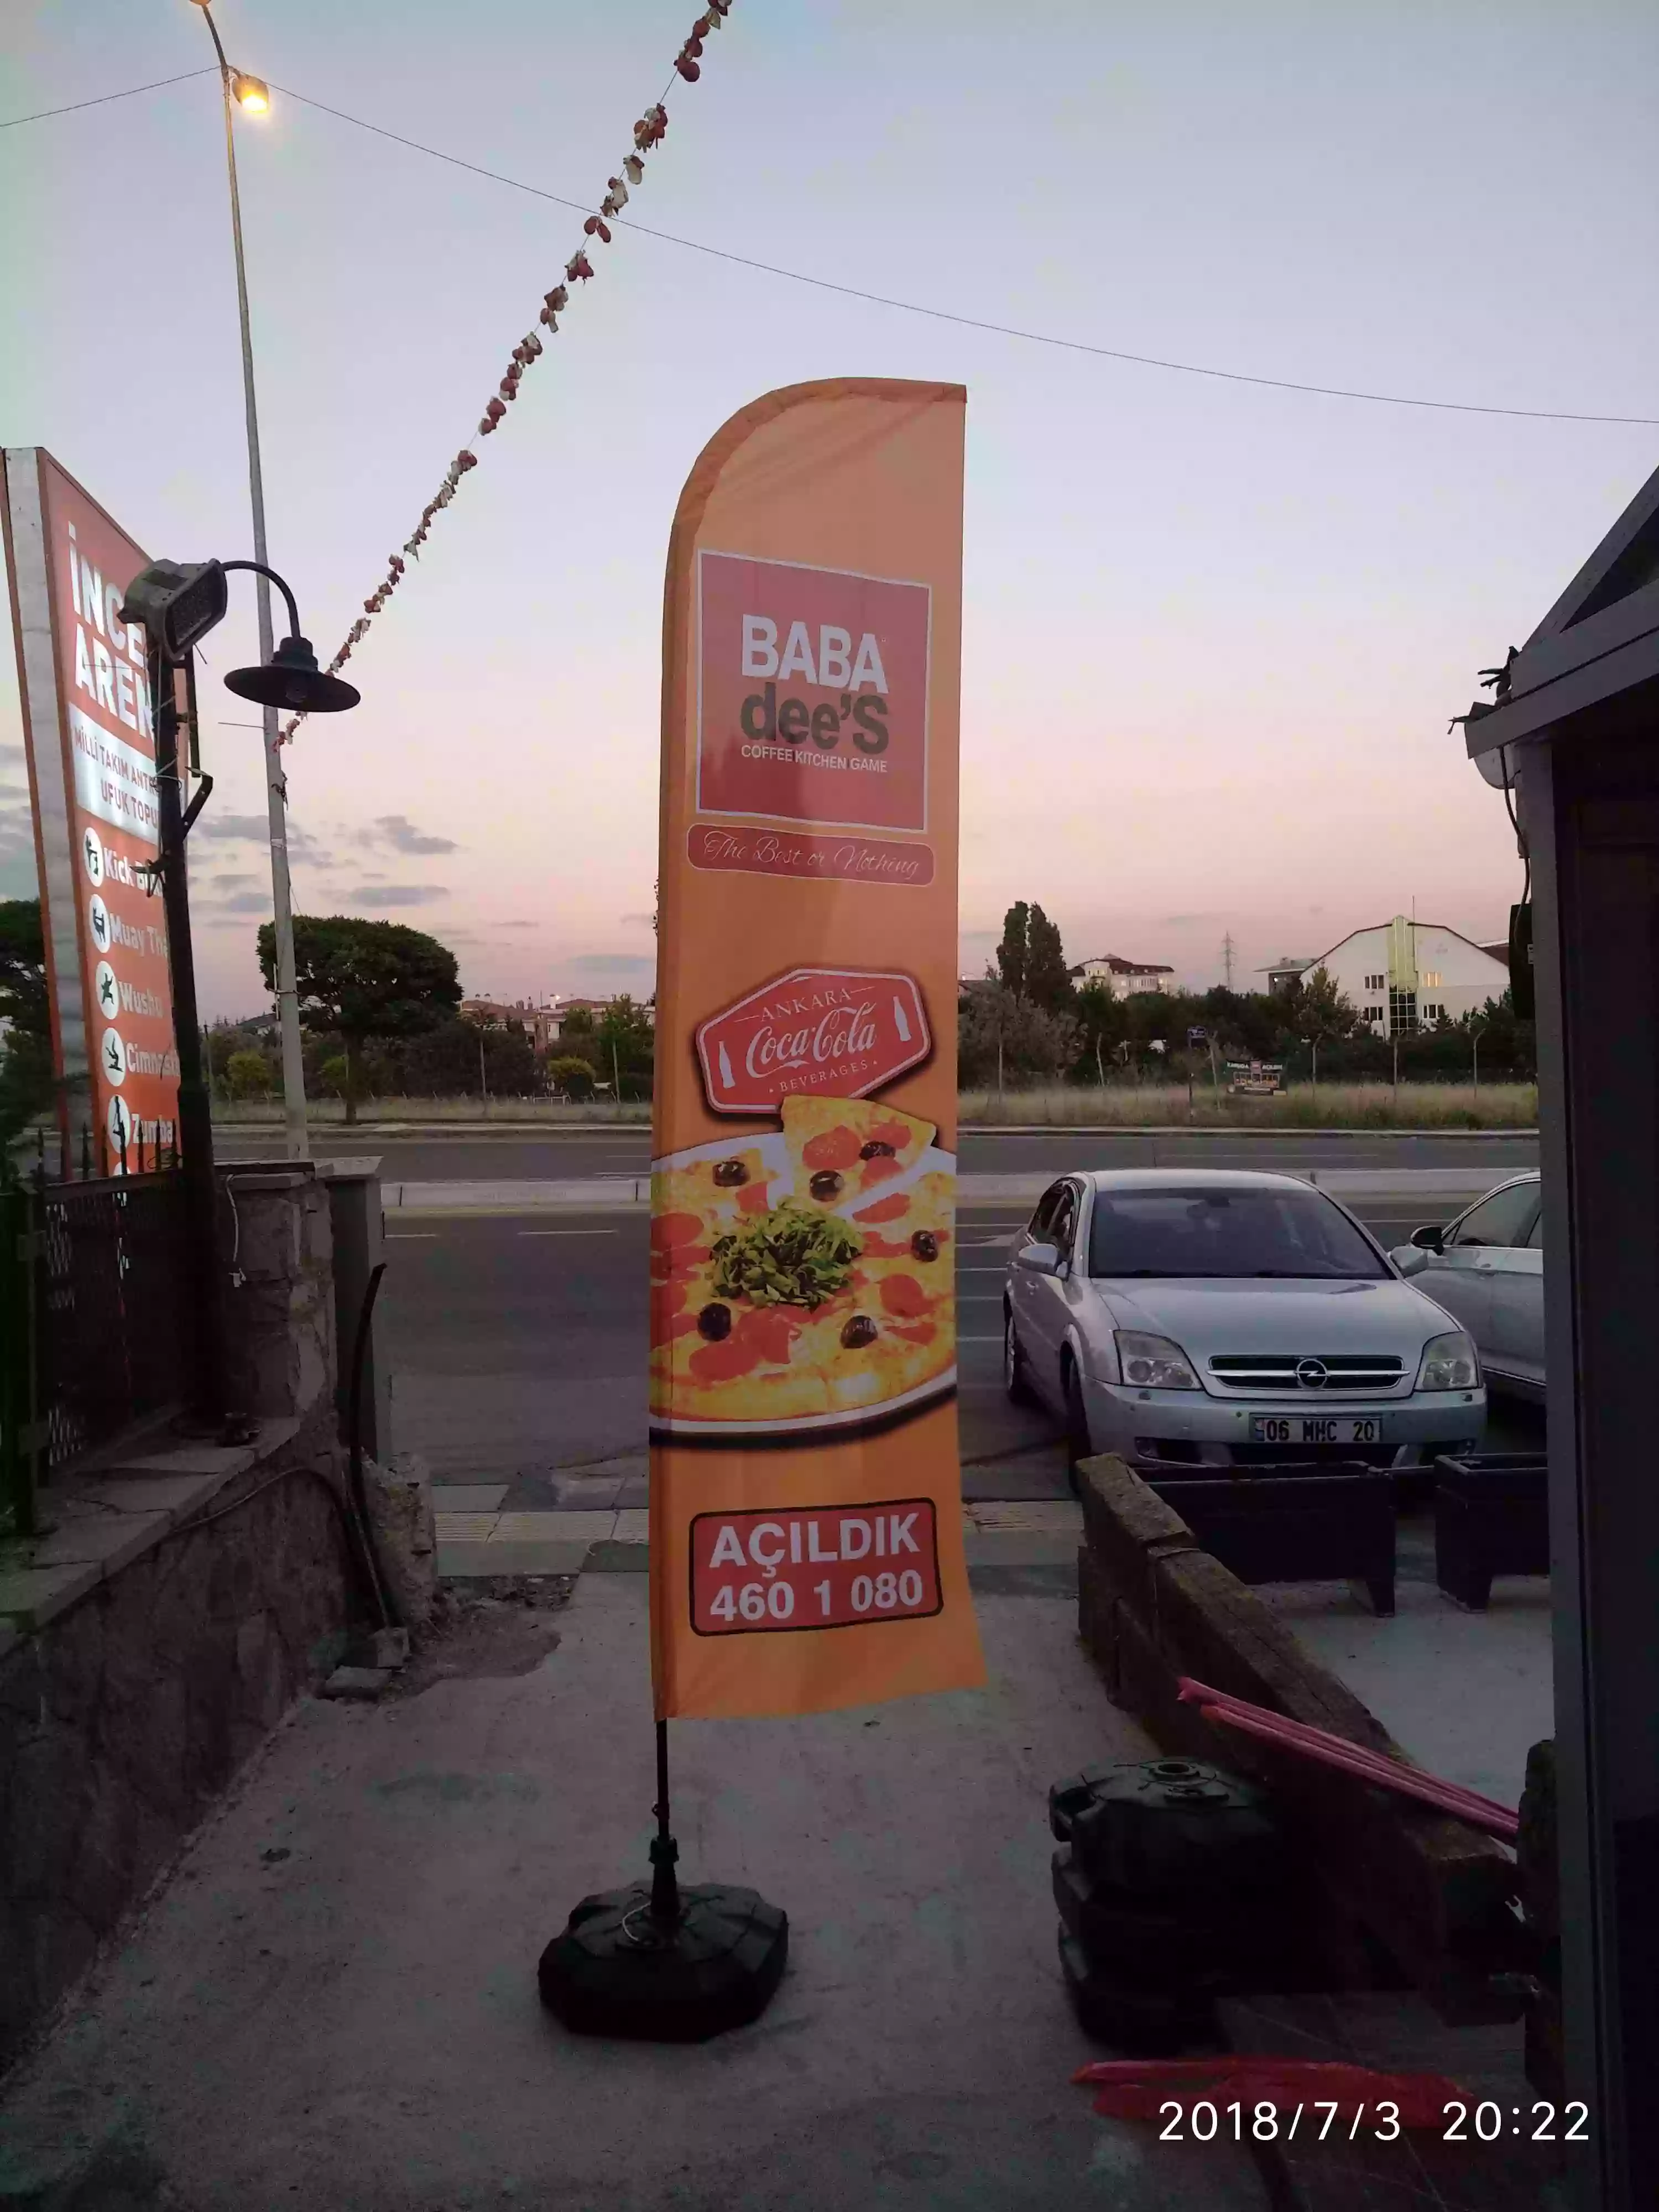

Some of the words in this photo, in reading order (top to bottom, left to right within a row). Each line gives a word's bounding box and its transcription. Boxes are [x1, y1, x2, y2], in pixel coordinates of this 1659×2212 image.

[68, 520, 147, 669] İNCE
[741, 613, 889, 694] BABA
[75, 623, 155, 744] AREN
[740, 682, 890, 755] dee'S
[74, 726, 98, 761] MİLLİ
[100, 744, 129, 781] TAKIM
[741, 744, 793, 762] COFFEE
[795, 750, 847, 770] KITCHEN
[850, 758, 888, 773] GAME
[101, 777, 130, 815] UFUK
[131, 796, 159, 829] TOPU
[103, 847, 135, 888] Kick
[703, 831, 748, 860] The
[754, 836, 803, 865] Best
[807, 853, 825, 867] or
[833, 845, 920, 880] Nothing
[109, 912, 145, 957] Muay
[118, 980, 164, 1019] Wushu
[760, 987, 853, 1022] ANKARA
[779, 1059, 868, 1092] BEVERAGES
[131, 1113, 173, 1145] Zumba
[1266, 1420, 1290, 1441] 06
[1302, 1420, 1337, 1442] MHC
[1353, 1420, 1375, 1441] 20
[709, 1512, 921, 1578] AÇILDIK
[710, 1581, 795, 1621] 460
[813, 1579, 831, 1615] 1
[851, 1569, 923, 1612] 080
